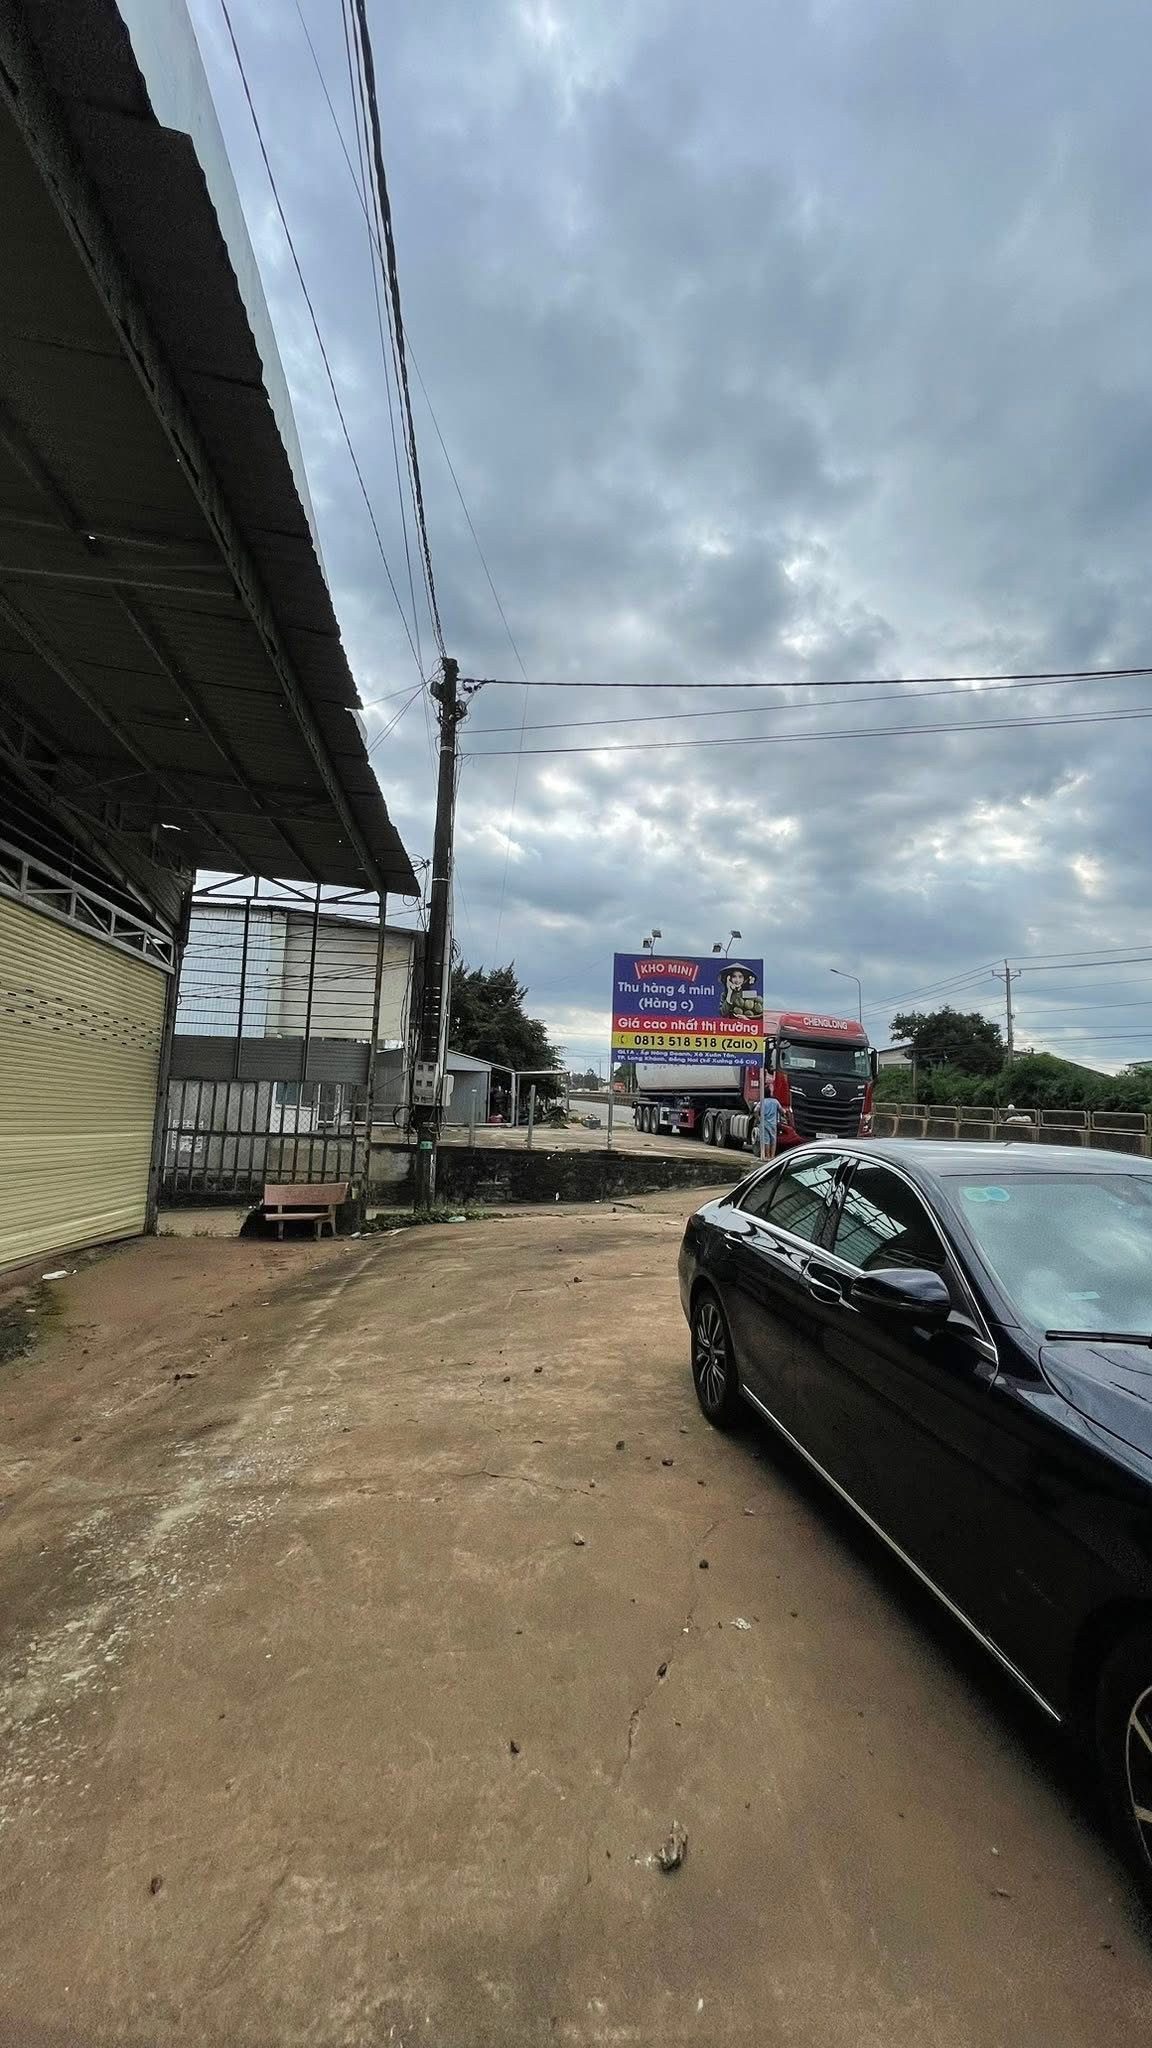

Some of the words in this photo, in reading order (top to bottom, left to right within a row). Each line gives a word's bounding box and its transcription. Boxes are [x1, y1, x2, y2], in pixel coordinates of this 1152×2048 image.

[640, 963, 664, 976] KHO
[667, 963, 693, 977] MINI
[618, 982, 639, 992] Thu
[643, 982, 674, 995] hàng
[677, 986, 686, 995] 4
[689, 985, 715, 996] mini
[638, 998, 677, 1011] (Hàng
[680, 1000, 694, 1012] c)
[618, 1017, 640, 1029] Giá
[643, 1021, 667, 1030] cao
[670, 1018, 698, 1031] nhất
[701, 1021, 716, 1034] thị
[720, 1020, 759, 1035] trường
[803, 1017, 848, 1030] CHENGLONG
[634, 1035, 664, 1046] 0813
[668, 1036, 690, 1047] 518
[695, 1036, 717, 1048] 518
[721, 1038, 758, 1051] (Zalo)
